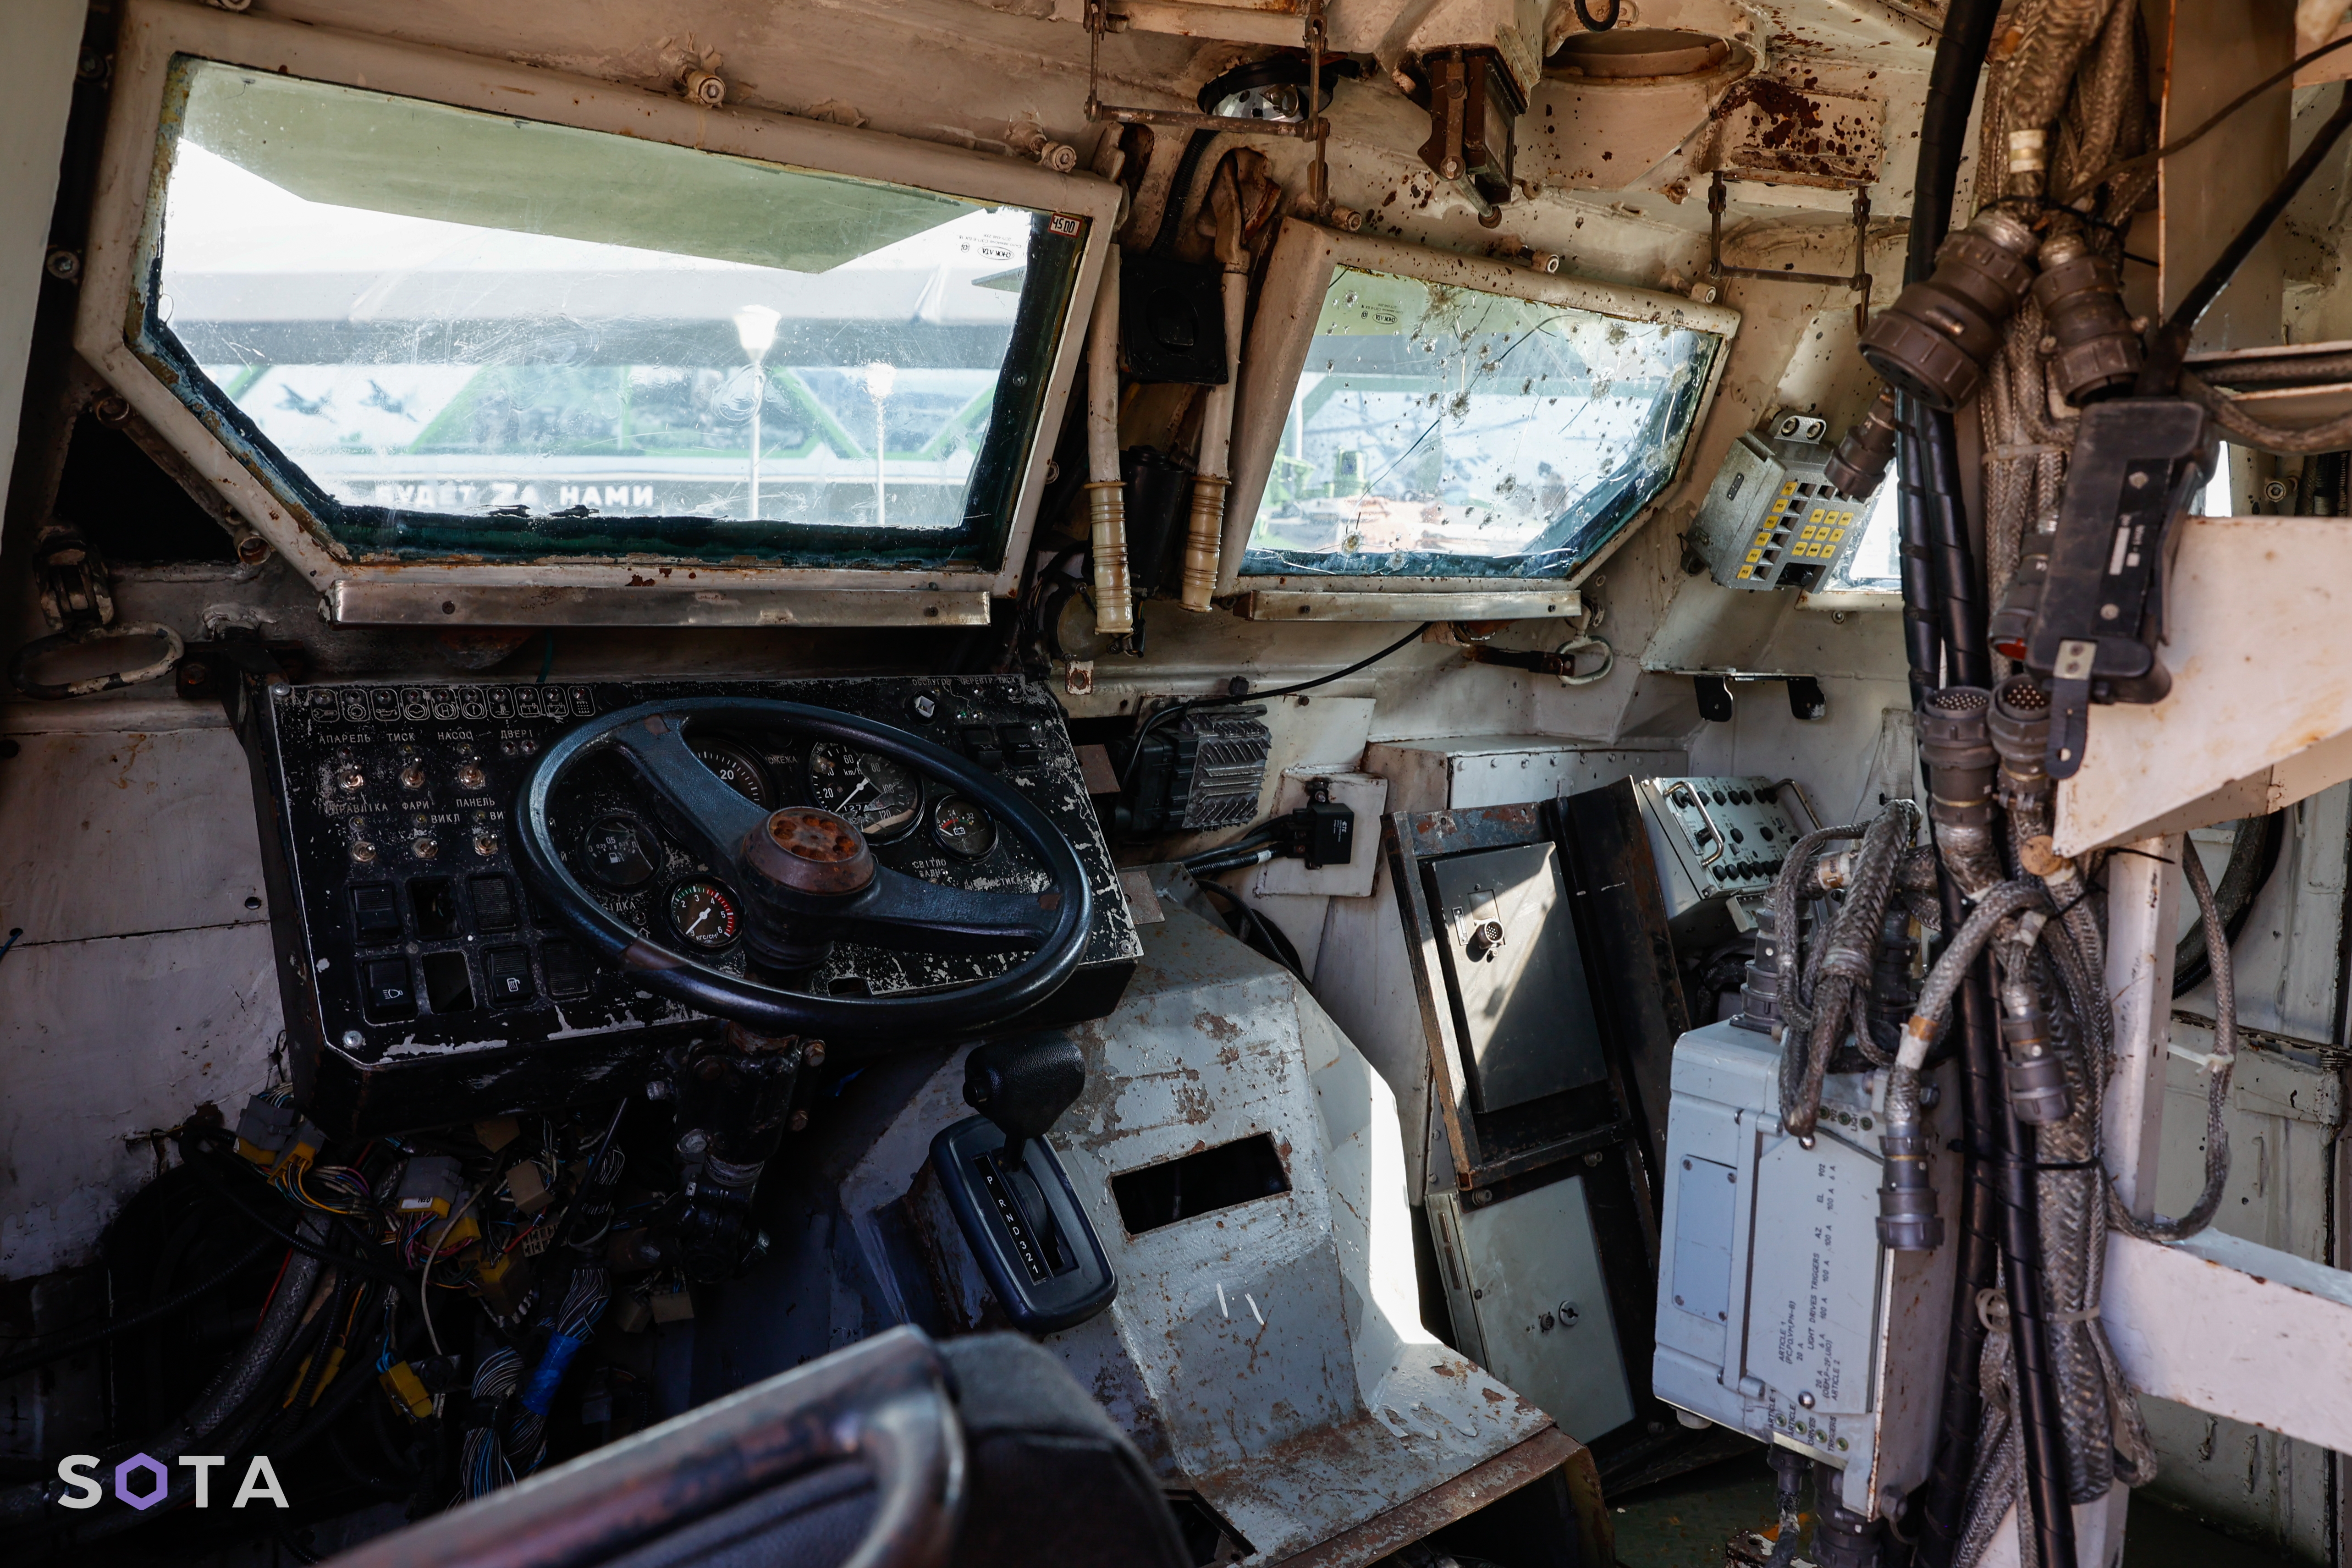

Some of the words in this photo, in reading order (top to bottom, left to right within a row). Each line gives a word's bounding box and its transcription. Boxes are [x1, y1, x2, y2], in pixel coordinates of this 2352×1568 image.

[560, 485, 653, 506] НАМИ
[319, 734, 371, 743] АПАРЕЛЬ
[386, 733, 415, 742] ТИСК
[501, 730, 533, 739] ДВЕРІ
[766, 755, 798, 765] ОЖЕЖА
[843, 754, 854, 764] 60
[871, 763, 881, 772] 80
[720, 770, 734, 780] 20
[823, 788, 833, 798] 20
[882, 784, 894, 794] 100
[402, 801, 429, 810] ФАРИ
[456, 798, 496, 807] ПАНЕЛЬ
[431, 813, 460, 824] ВИКЛ
[879, 810, 892, 820] 120
[1817, 1194, 1824, 1203] EL
[987, 1176, 993, 1185] P
[998, 1199, 1006, 1208] R
[1006, 1213, 1014, 1222] N
[1013, 1227, 1020, 1236] D
[1019, 1241, 1027, 1249] 3
[1026, 1253, 1033, 1262] 2
[1032, 1265, 1039, 1273] 1
[1815, 1227, 1822, 1239] AZ
[1811, 1252, 1820, 1290] TRIGGERS
[1809, 1294, 1817, 1323] DRIVES
[1797, 1352, 1803, 1361] 20
[1832, 1367, 1840, 1401] ARTICLE
